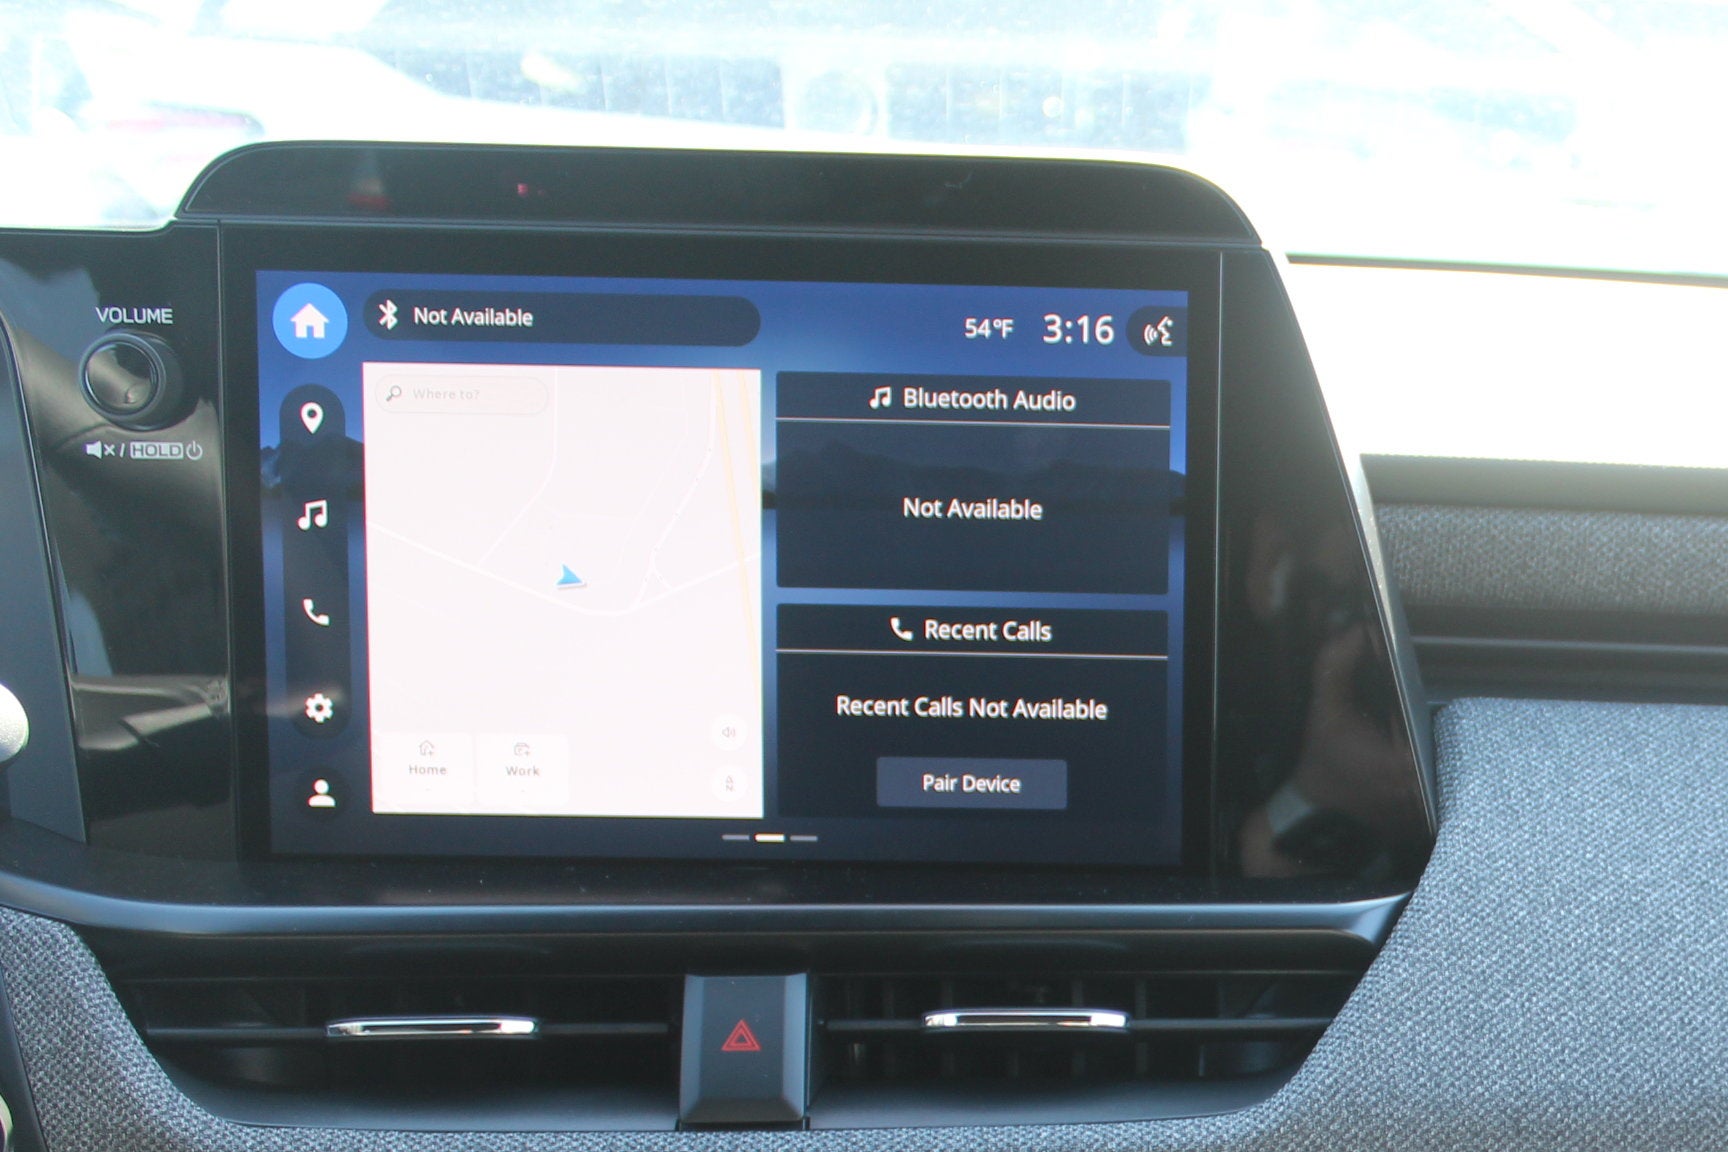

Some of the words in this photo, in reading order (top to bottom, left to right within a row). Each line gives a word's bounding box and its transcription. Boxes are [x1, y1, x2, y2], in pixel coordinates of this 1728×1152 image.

[95, 306, 174, 325] VOLUME
[413, 306, 448, 326] Not
[450, 307, 535, 328] Available
[1042, 312, 1116, 345] 3:16
[412, 387, 457, 401] Where
[459, 387, 481, 401] to?
[902, 385, 1008, 411] Bluetooth
[1013, 388, 1077, 412] Audio
[131, 442, 184, 459] HOLD
[902, 497, 943, 520] Not
[947, 498, 1044, 522] Available
[924, 618, 997, 642] Recent
[1002, 619, 1053, 643] Calls
[835, 695, 909, 718] Recent
[913, 696, 964, 719] Calls
[968, 697, 1008, 720] Not
[1012, 698, 1109, 722] Available
[408, 764, 447, 777] Home
[505, 765, 540, 778] Work
[922, 773, 958, 794] Pair
[962, 774, 1022, 796] Device
